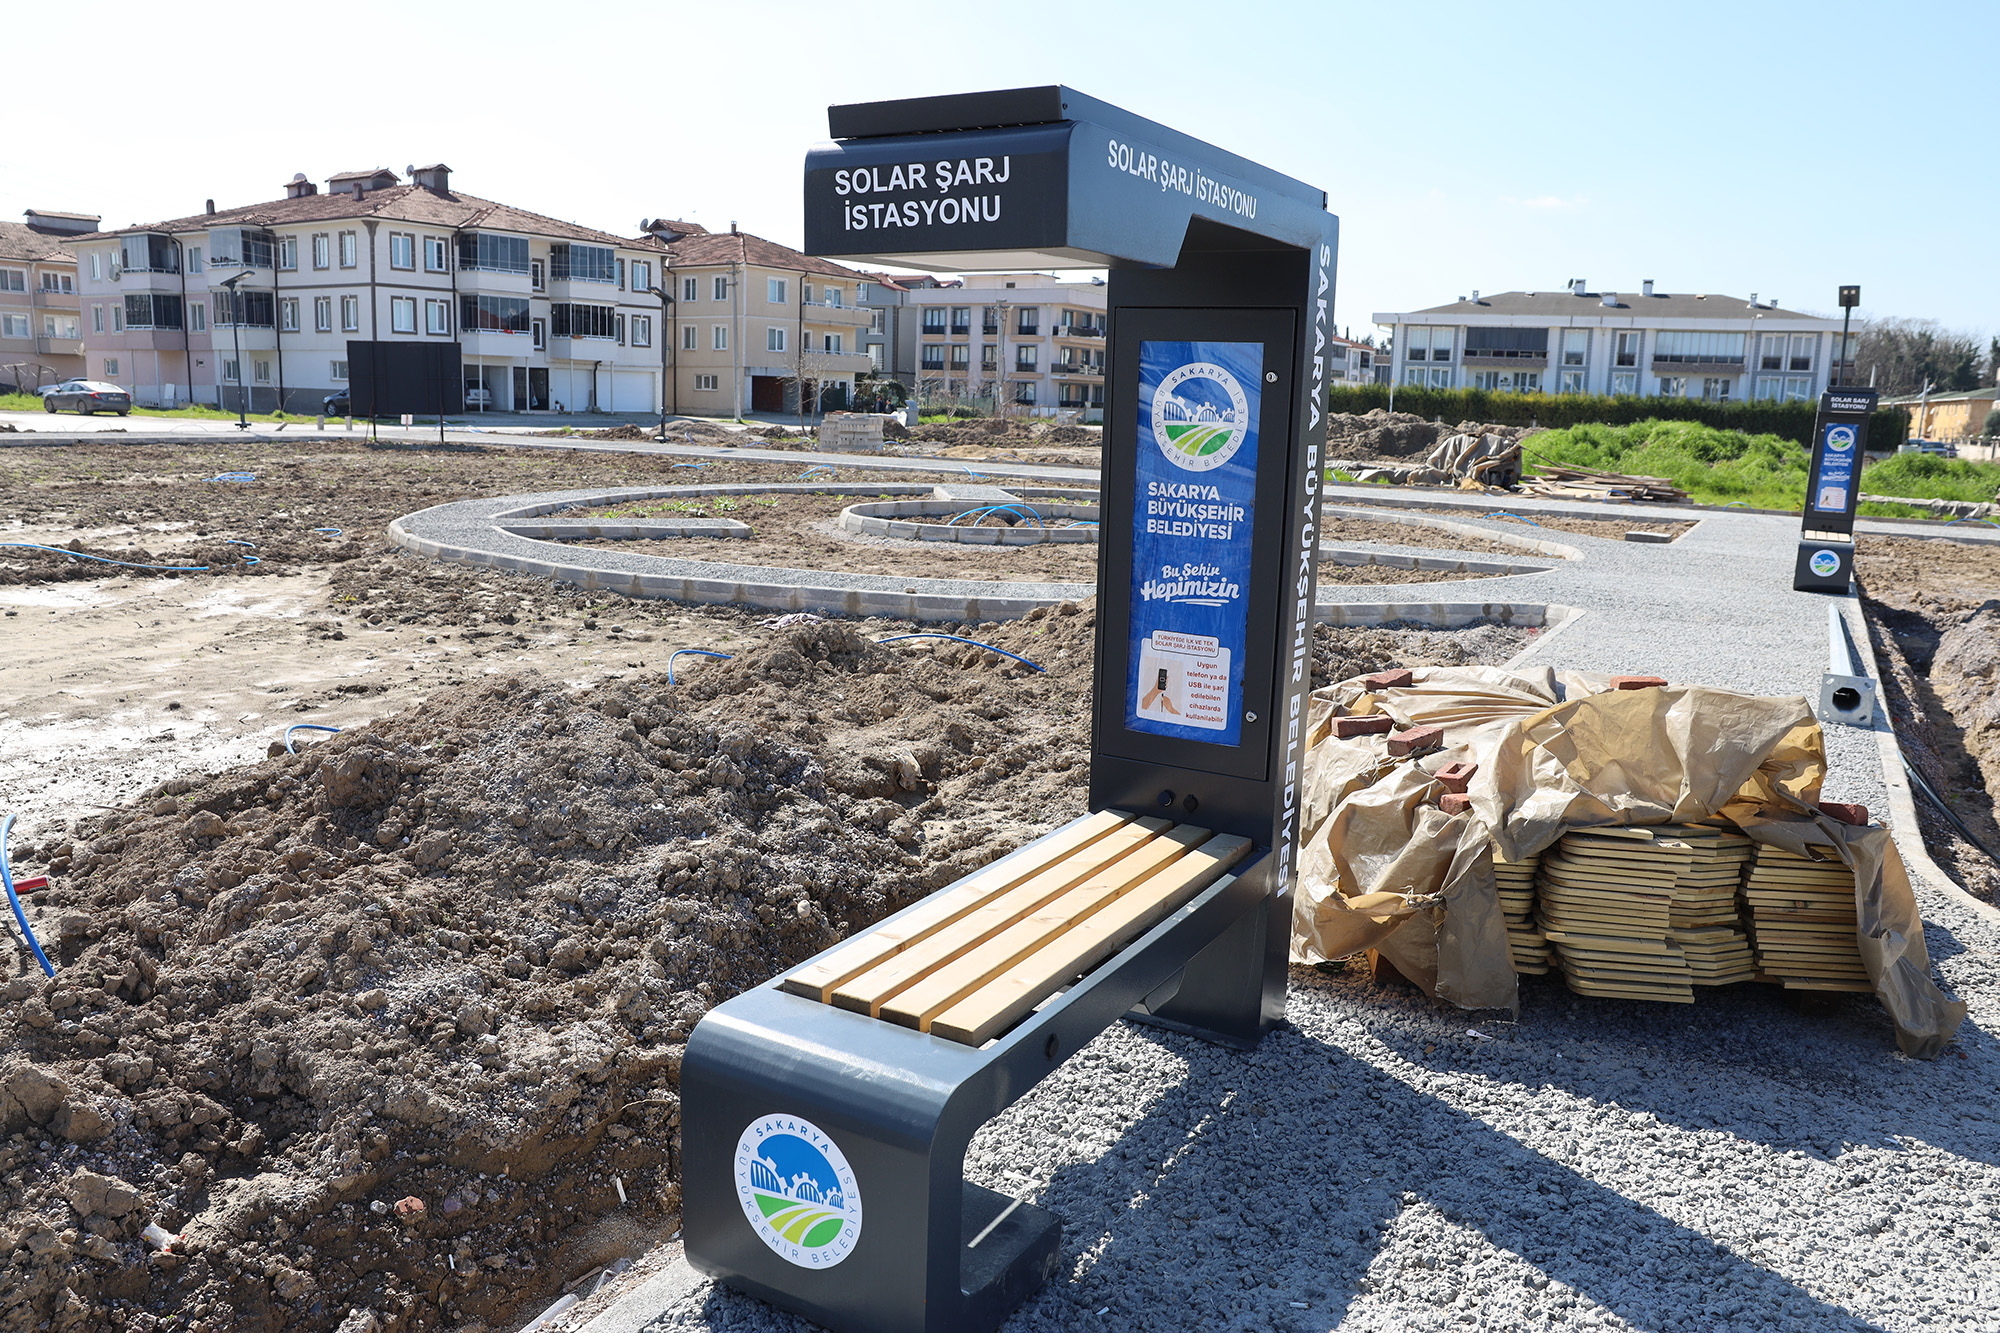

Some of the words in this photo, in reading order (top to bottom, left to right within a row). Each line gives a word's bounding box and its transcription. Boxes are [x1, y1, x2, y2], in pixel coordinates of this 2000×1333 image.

[834, 162, 927, 196] SOLAR
[935, 156, 1011, 195] ŞARJ
[1107, 139, 1158, 183] SOLAR
[1160, 156, 1194, 199] ŞARJ
[1195, 168, 1258, 219] İSTASYONU
[844, 194, 1001, 230] İSTASYONU
[1308, 242, 1332, 432] SAKARYA
[1171, 367, 1229, 386] SAKARYA
[1147, 481, 1220, 501] SAKARYA
[1147, 498, 1245, 522] BÜYÜKŞEHİR
[1146, 519, 1233, 540] BELEDİYESİ
[1161, 564, 1180, 579] Bu
[1182, 562, 1220, 580] Şehir
[1291, 444, 1319, 685] BÜYÜKŞEHİR
[1140, 576, 1240, 602] Hepimizin
[1186, 671, 1208, 679] telefon
[1197, 661, 1218, 670] Uygun
[1188, 681, 1202, 689] USB
[1189, 703, 1221, 712] cihazlarda
[1276, 692, 1301, 899] BELEDİYESİ
[756, 1120, 829, 1154] SAKARYA
